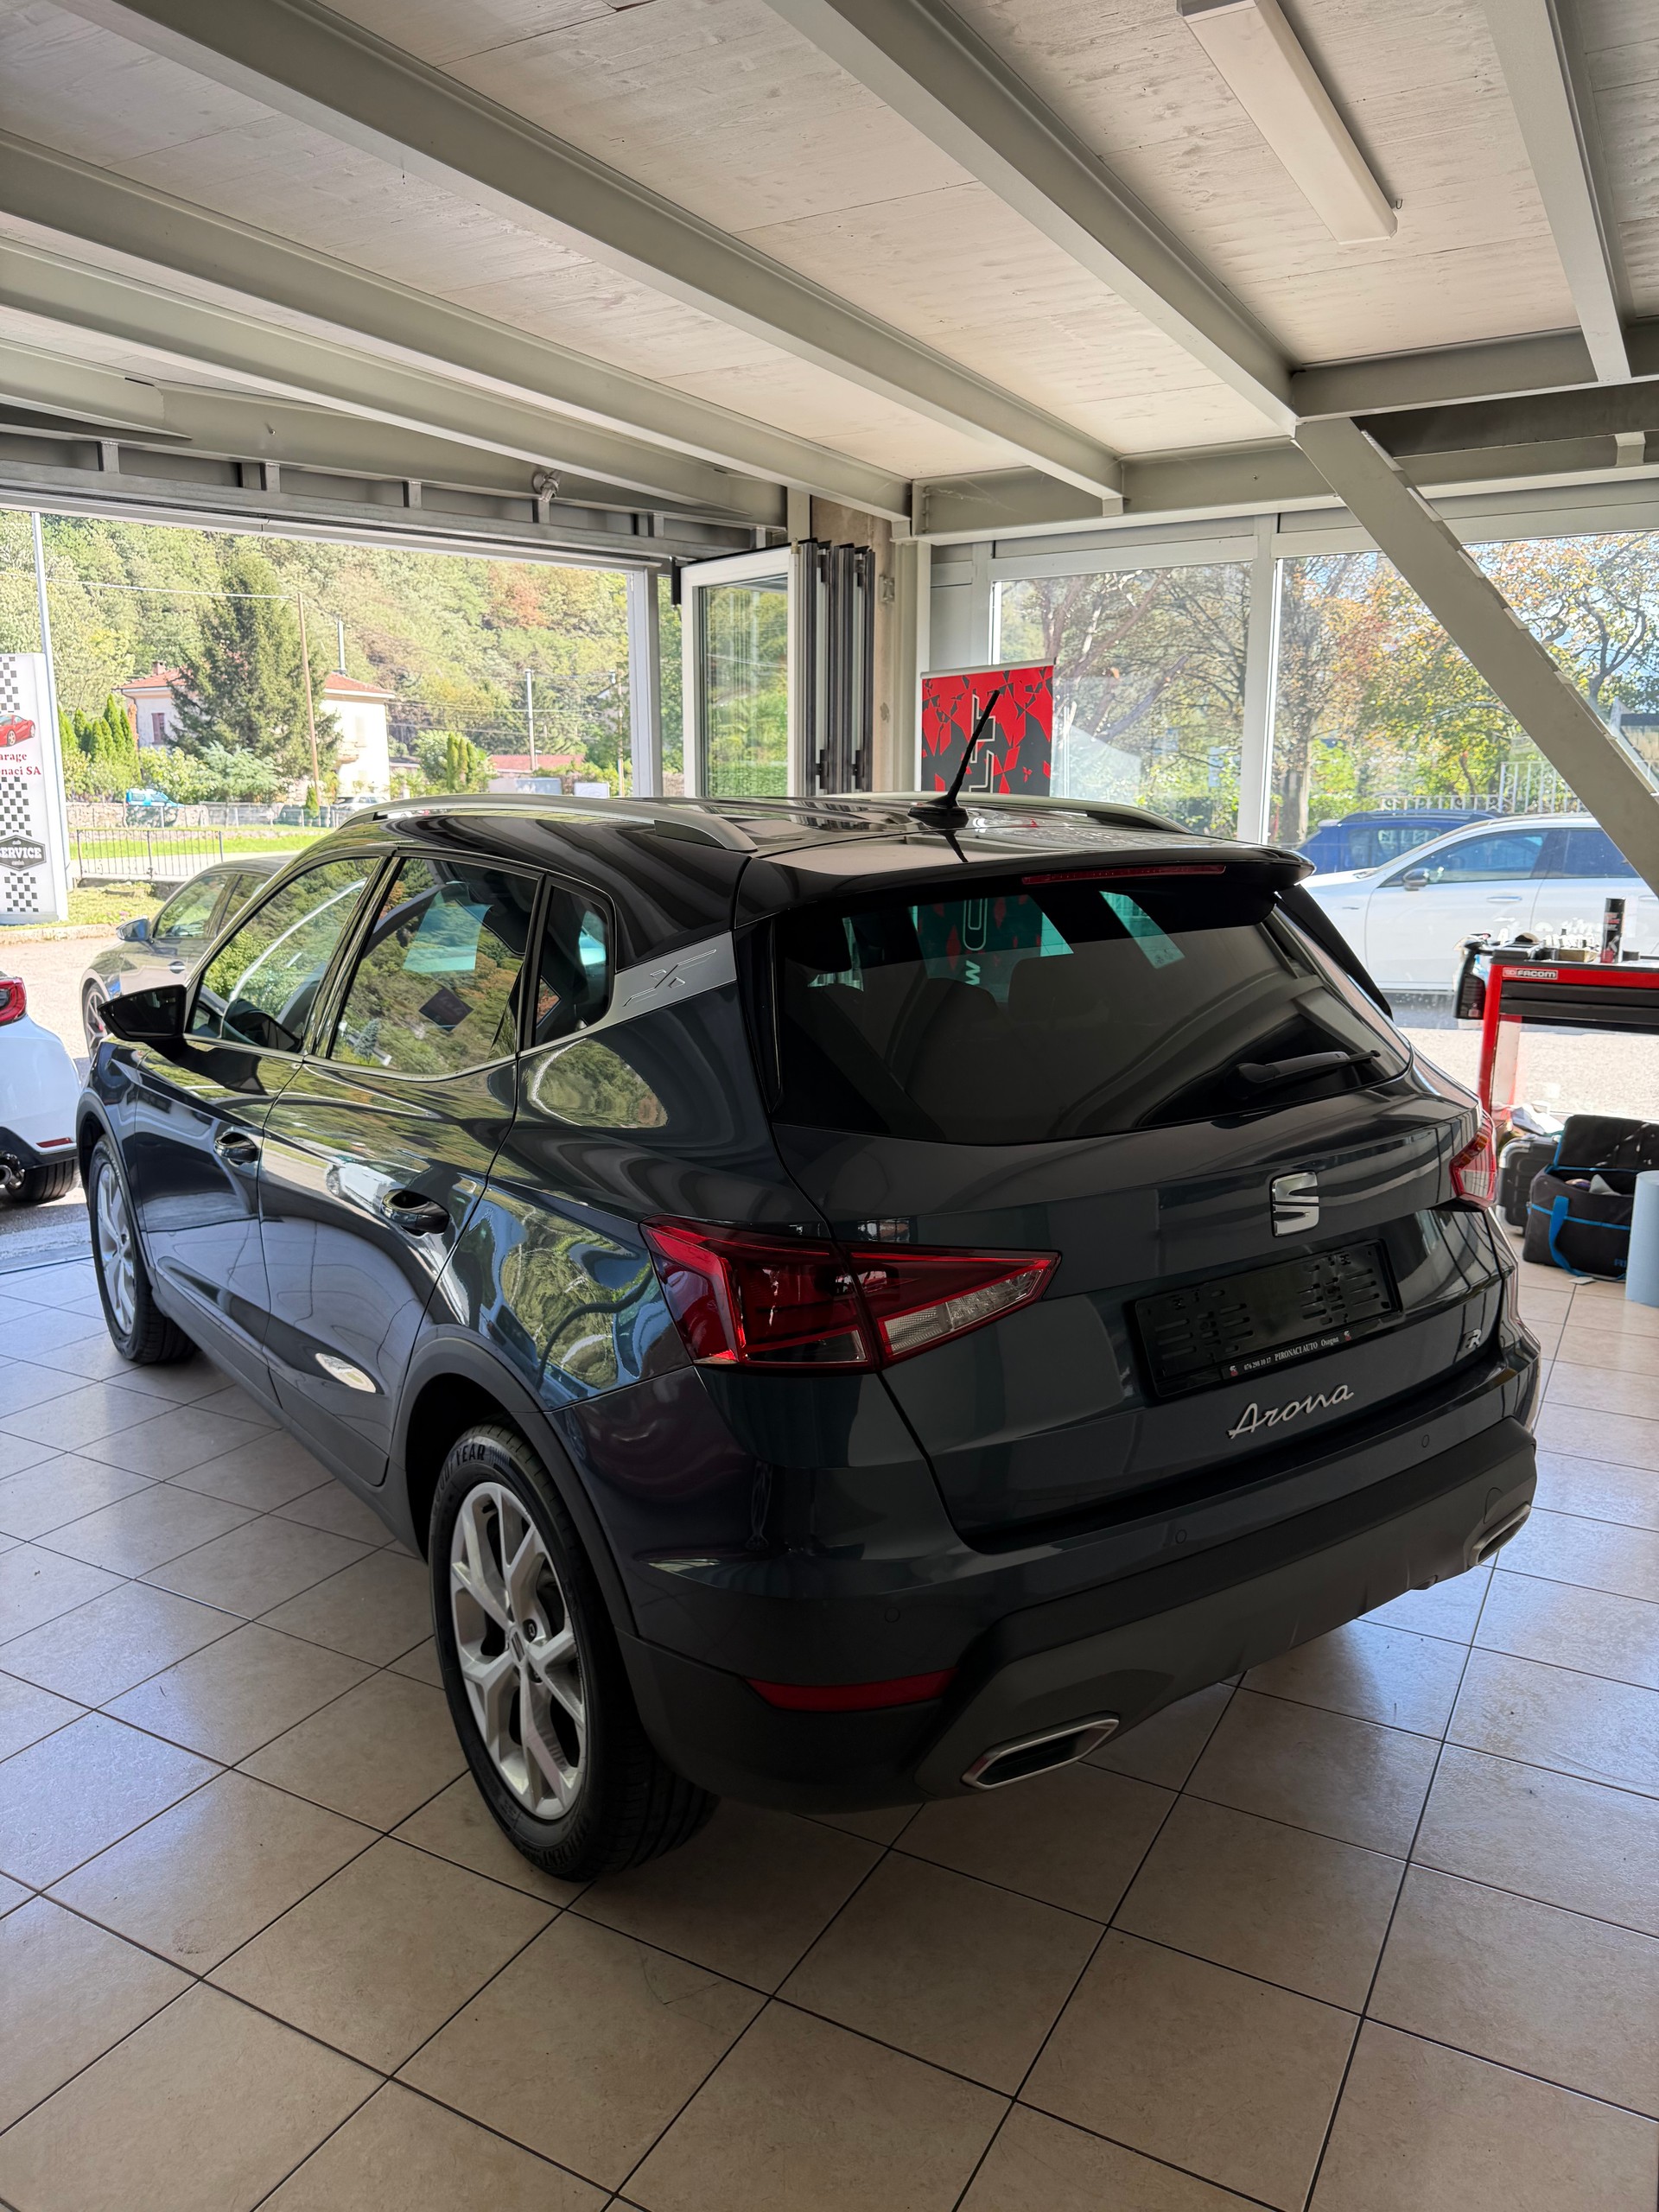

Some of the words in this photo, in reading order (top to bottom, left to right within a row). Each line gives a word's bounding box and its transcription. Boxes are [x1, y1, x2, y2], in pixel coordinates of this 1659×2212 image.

[0, 753, 27, 763] arage
[1, 766, 23, 775] naci
[26, 766, 41, 775] SA
[0, 847, 42, 859] ERVICE
[1274, 1346, 1302, 1362] PIRONACI
[1302, 1341, 1318, 1352] AUTO
[1226, 1384, 1355, 1440] Arona
